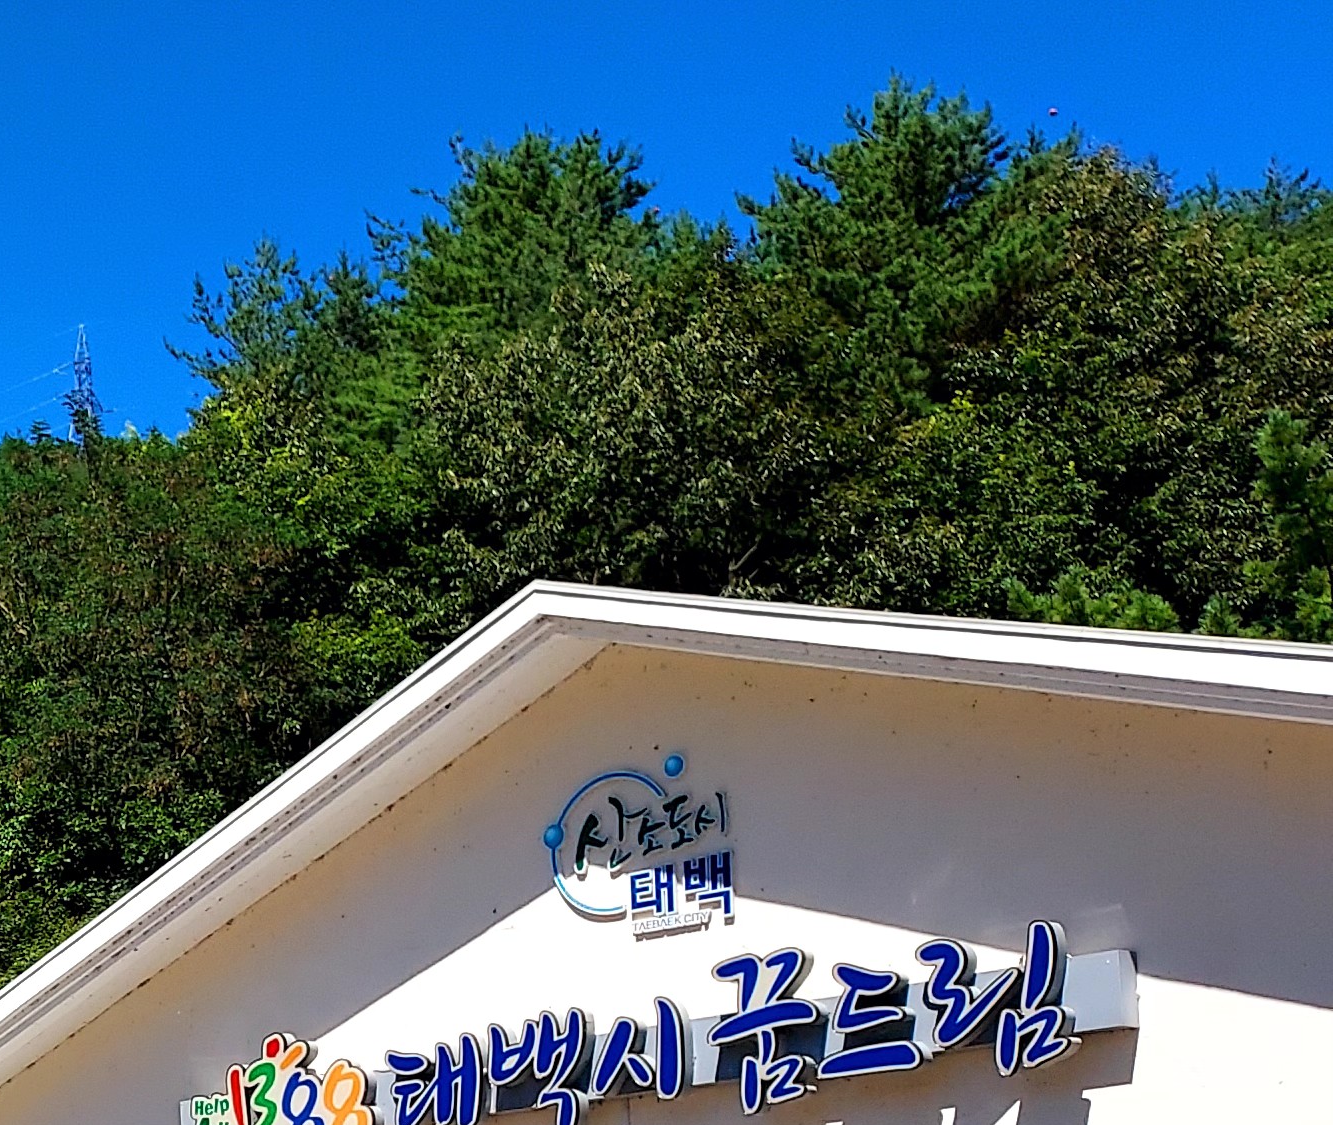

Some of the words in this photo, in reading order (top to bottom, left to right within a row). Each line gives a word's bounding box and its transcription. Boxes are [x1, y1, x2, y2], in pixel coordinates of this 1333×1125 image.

[575, 791, 727, 871] 산소도시
[630, 850, 733, 915] 태백
[632, 916, 683, 931] TAEBAEK
[684, 911, 710, 924] CITY
[709, 921, 1071, 1113] 꿈드림
[194, 1098, 230, 1116] Help
